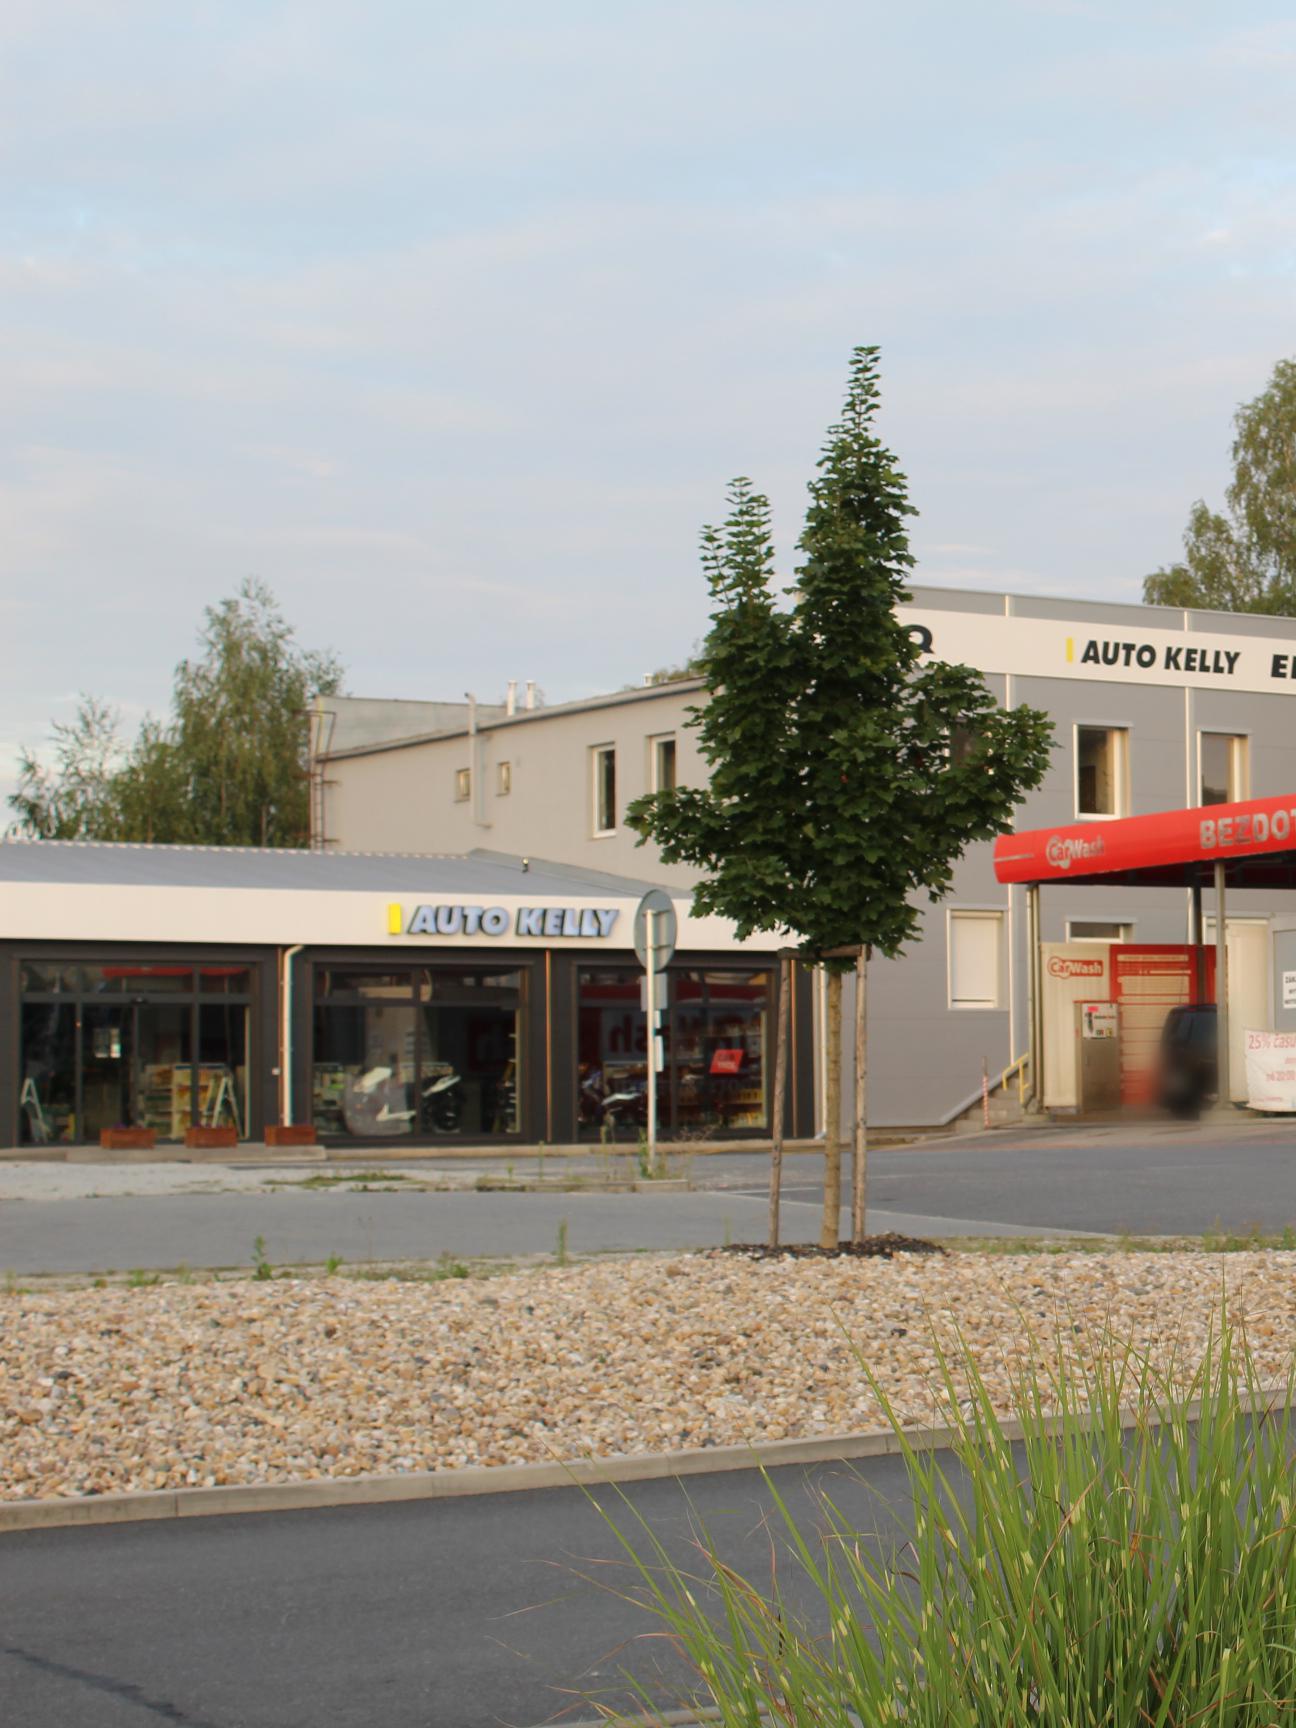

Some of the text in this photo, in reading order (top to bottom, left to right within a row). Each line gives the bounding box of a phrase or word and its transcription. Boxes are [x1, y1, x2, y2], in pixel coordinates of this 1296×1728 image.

[1081, 640, 1242, 675] AUTO KELLY
[407, 905, 620, 938] AUTO KELLY
